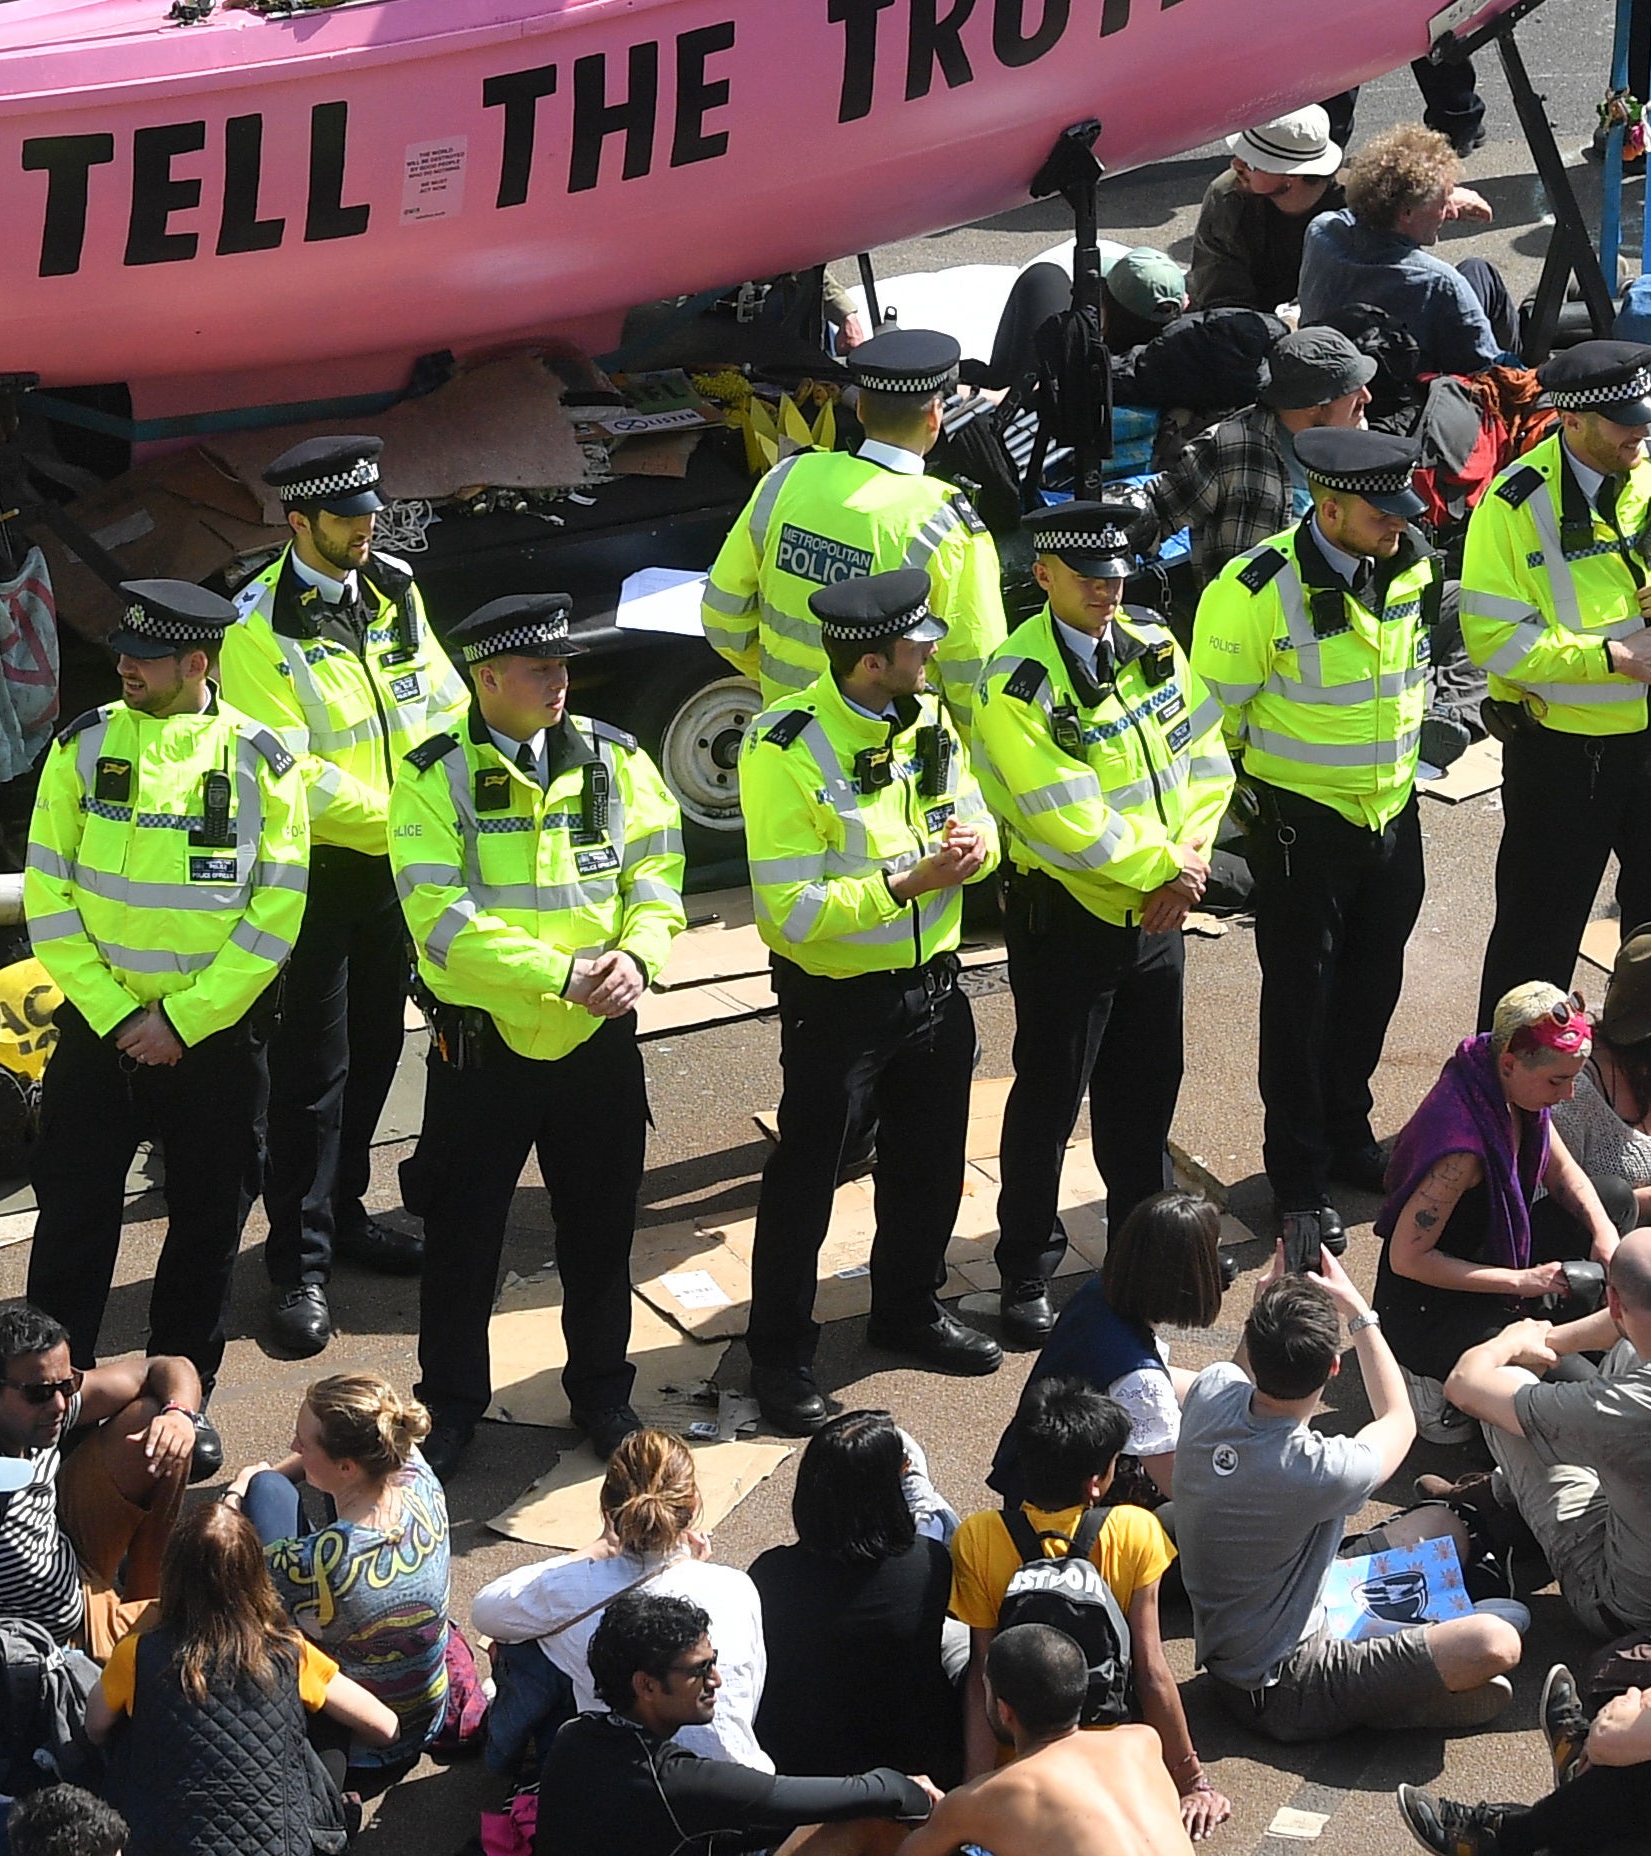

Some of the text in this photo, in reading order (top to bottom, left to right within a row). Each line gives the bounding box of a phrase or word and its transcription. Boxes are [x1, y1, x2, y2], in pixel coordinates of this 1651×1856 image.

[22, 101, 370, 277] TELL
[483, 21, 735, 209] THE
[648, 411, 698, 427] LISTEN
[782, 525, 871, 567] METROPOLITAN
[1209, 635, 1240, 655] POLICE
[395, 824, 422, 841] LICE
[191, 871, 235, 880] POLICE OFFICER
[1008, 1568, 1050, 1592] UST
